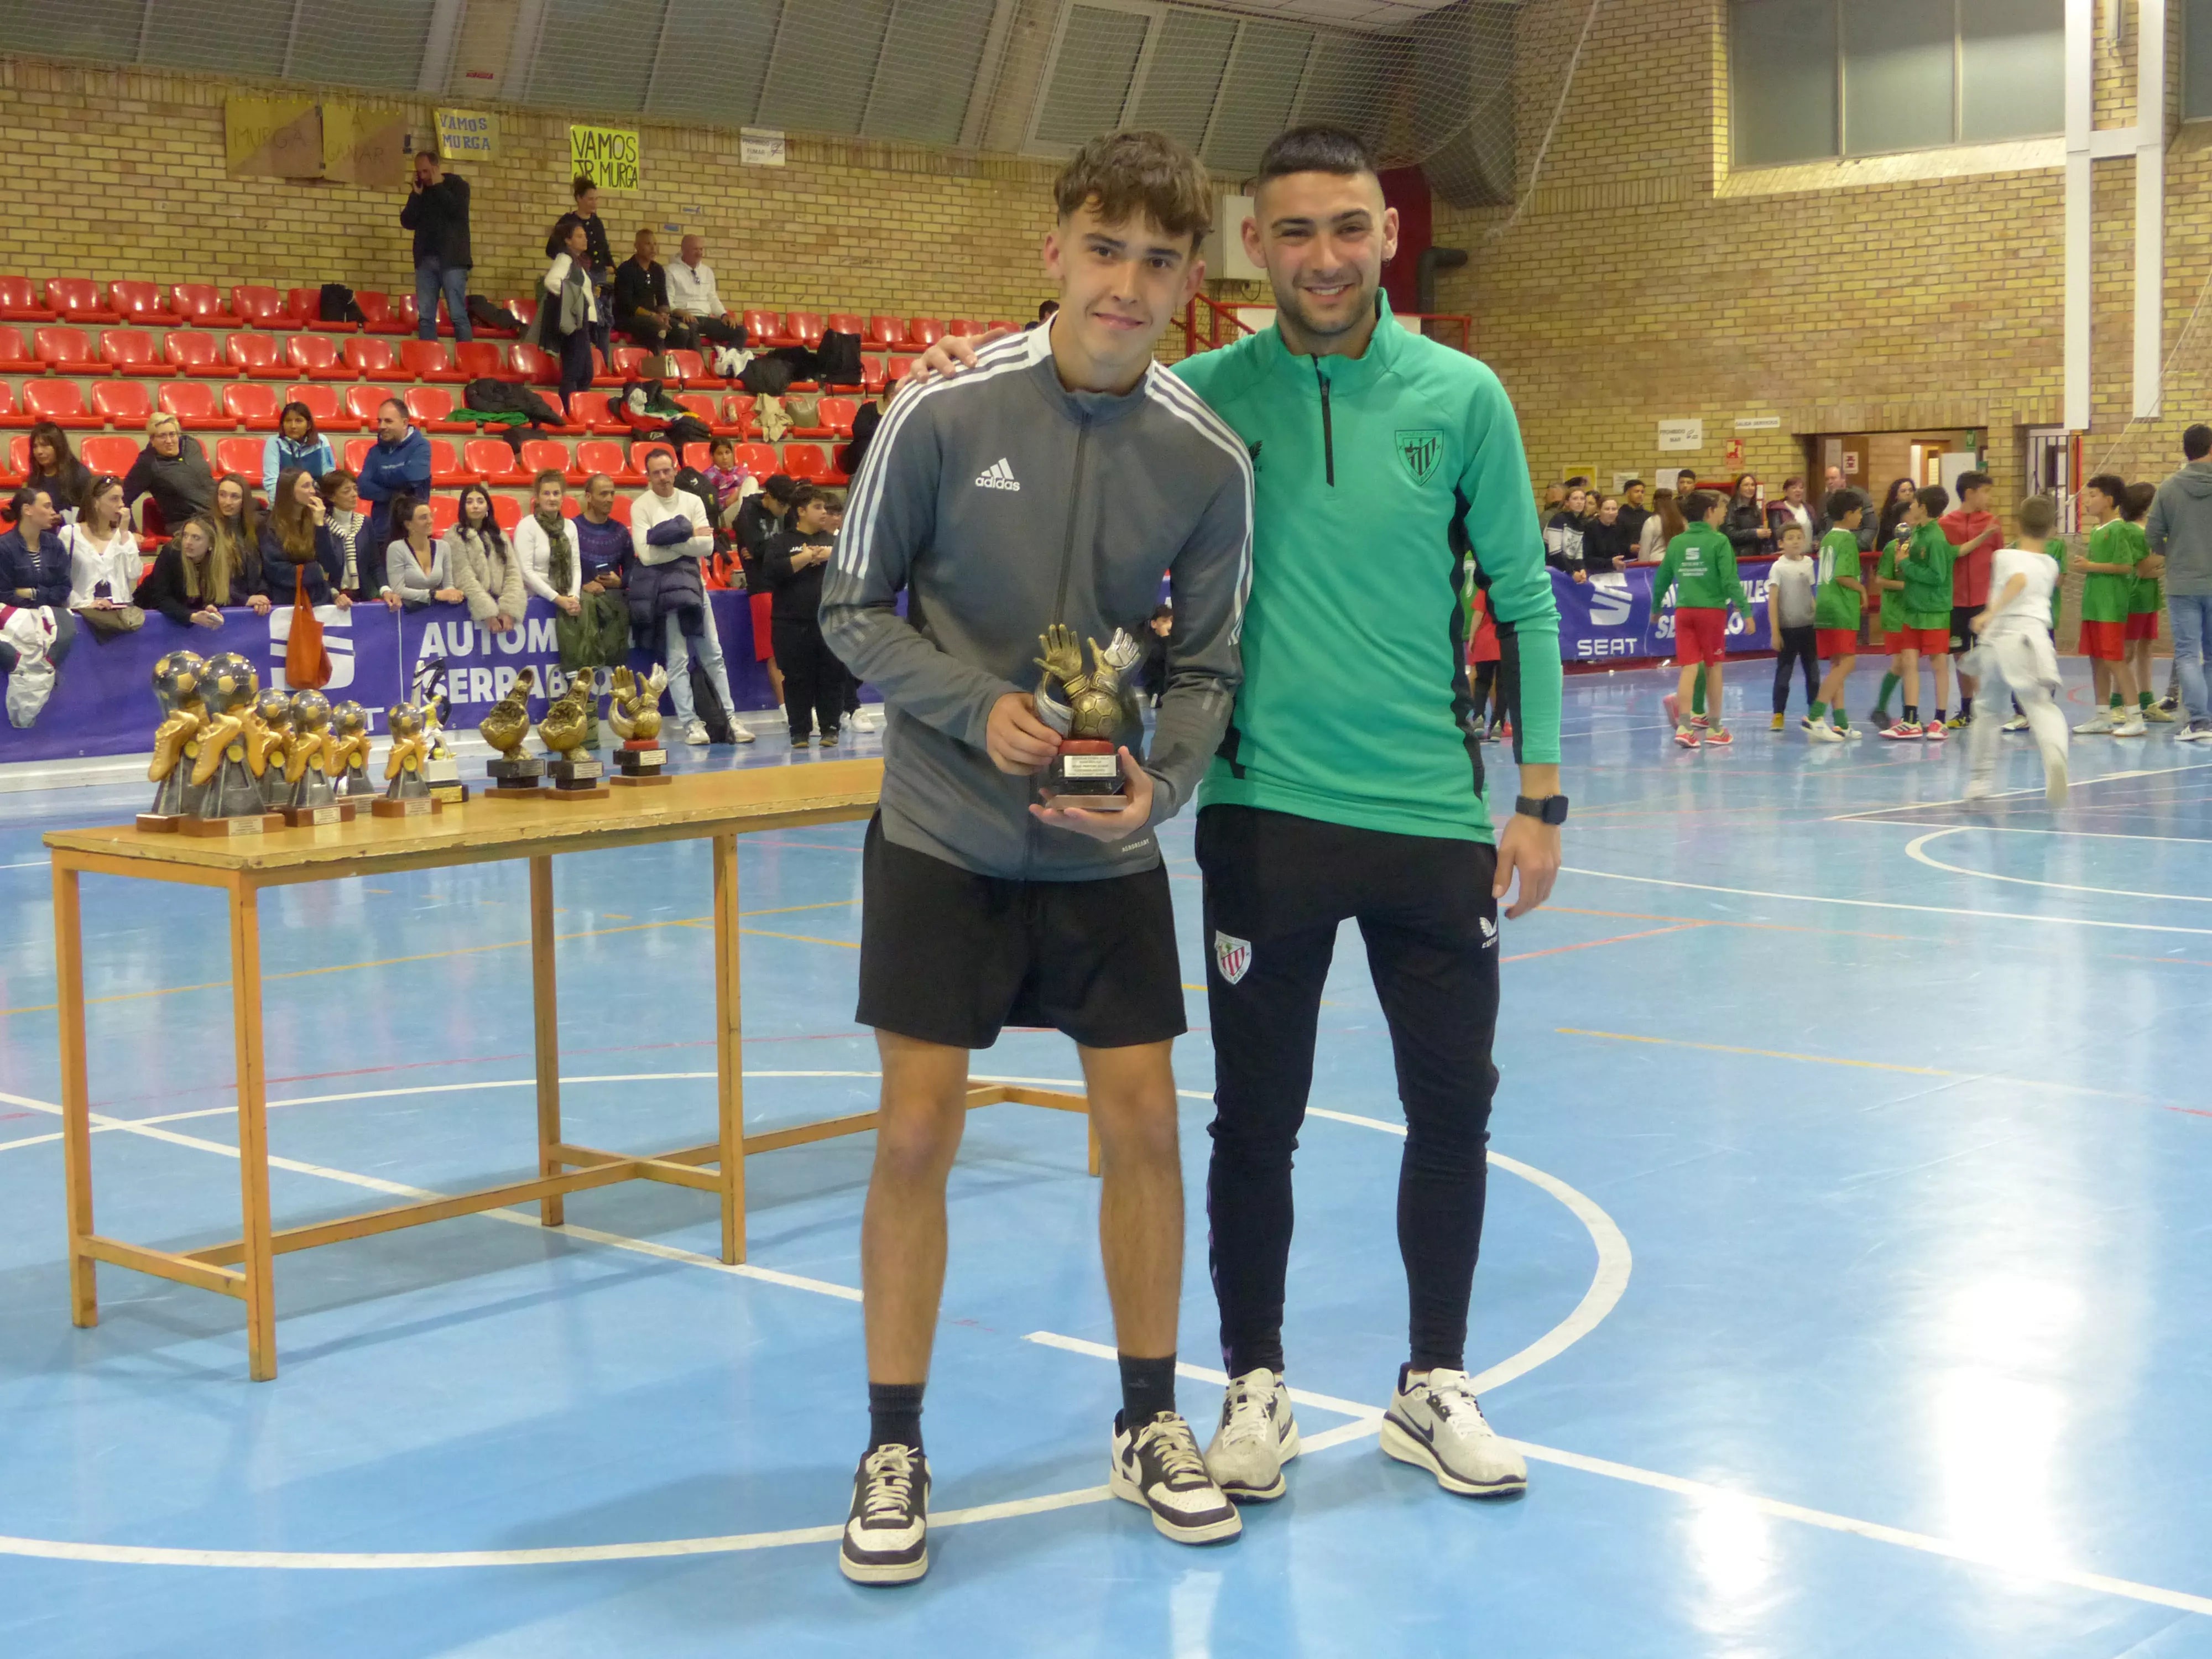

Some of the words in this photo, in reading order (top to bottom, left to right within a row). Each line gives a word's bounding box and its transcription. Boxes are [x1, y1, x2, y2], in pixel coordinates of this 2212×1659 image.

[441, 114, 488, 132] VAMOS
[233, 127, 307, 149] MURGA
[442, 134, 491, 150] MURGA
[572, 130, 637, 163] VAMOS
[599, 161, 638, 189] MURGA
[975, 476, 1021, 492] adidas
[1818, 545, 1835, 585] 10
[1577, 638, 1638, 656] SEAT
[422, 665, 615, 705] SERRABO
